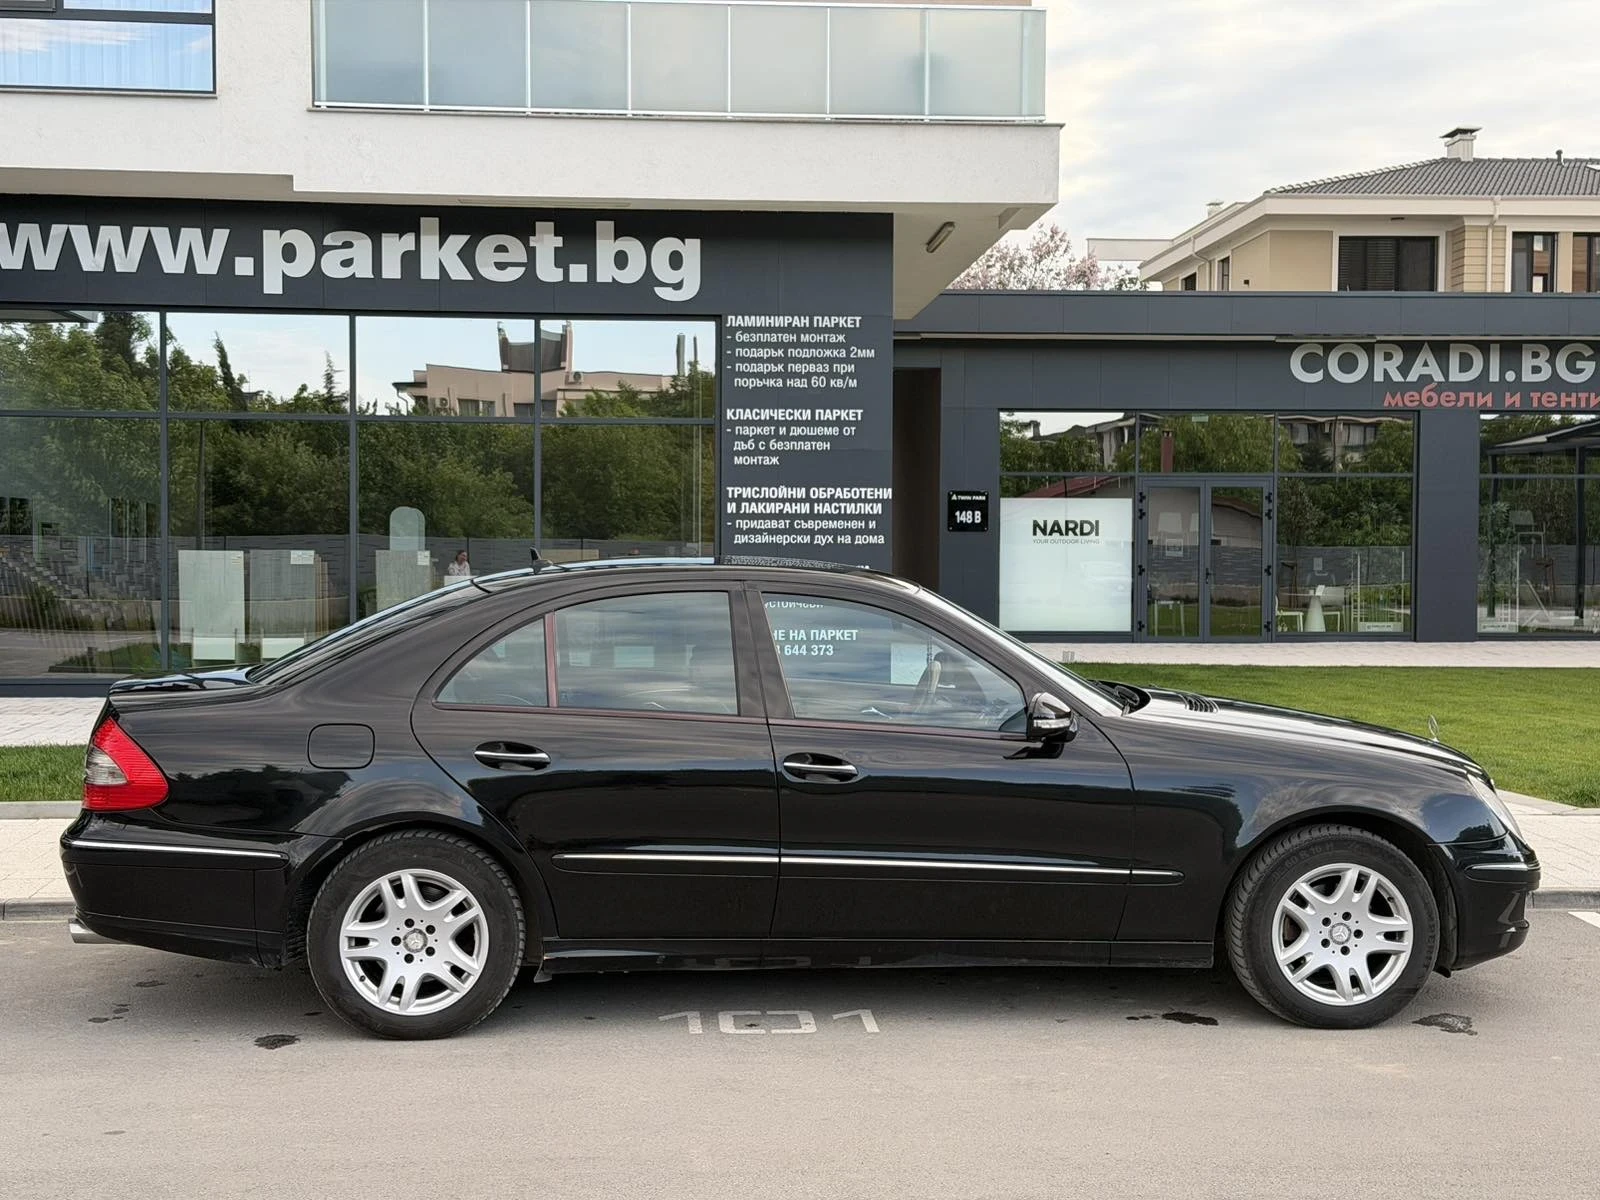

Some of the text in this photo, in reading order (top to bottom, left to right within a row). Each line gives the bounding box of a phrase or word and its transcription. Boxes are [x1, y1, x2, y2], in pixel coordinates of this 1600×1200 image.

[0, 217, 701, 301] www.parket.bg
[726, 316, 862, 328] ЛАМИНИРАН ПАРКЕТ
[736, 331, 797, 343] безплатен
[801, 334, 846, 343] монтаж
[736, 348, 785, 360] подарък
[788, 348, 847, 359] подложка
[850, 346, 875, 359] 2мм
[736, 363, 785, 375] подарък
[788, 364, 830, 375] перваз
[834, 364, 855, 375] при
[1290, 342, 1596, 383] CORADI.BG
[735, 376, 858, 390] поръчка над 60 кв/м
[1383, 382, 1493, 408] мебели
[1505, 391, 1521, 408] и
[727, 409, 864, 421] КЛАСИЧЕСКИ ПАРКЕТ
[736, 426, 776, 438] паркет
[779, 427, 787, 436] и
[790, 427, 840, 437] дюшеме
[843, 427, 857, 436] от
[734, 439, 831, 452] дъб с безплатен
[734, 456, 780, 466] монтаж
[727, 486, 893, 500] ТРИСЛОЙНИ ОБРАБОТЕНИ
[727, 502, 882, 515] И ЛАКИРАНИ НАСТИЛКИ
[955, 510, 973, 523] 148
[736, 520, 791, 531] придават
[794, 520, 865, 532] съвременен
[868, 520, 876, 529] и
[1033, 520, 1099, 536] NARDI
[734, 532, 885, 546] дизайнерски дух на дома
[790, 630, 807, 641] НА
[811, 630, 859, 641] ПАРКЕТ
[785, 645, 808, 656] 644
[811, 645, 834, 656] 373
[658, 1009, 880, 1034] 101
